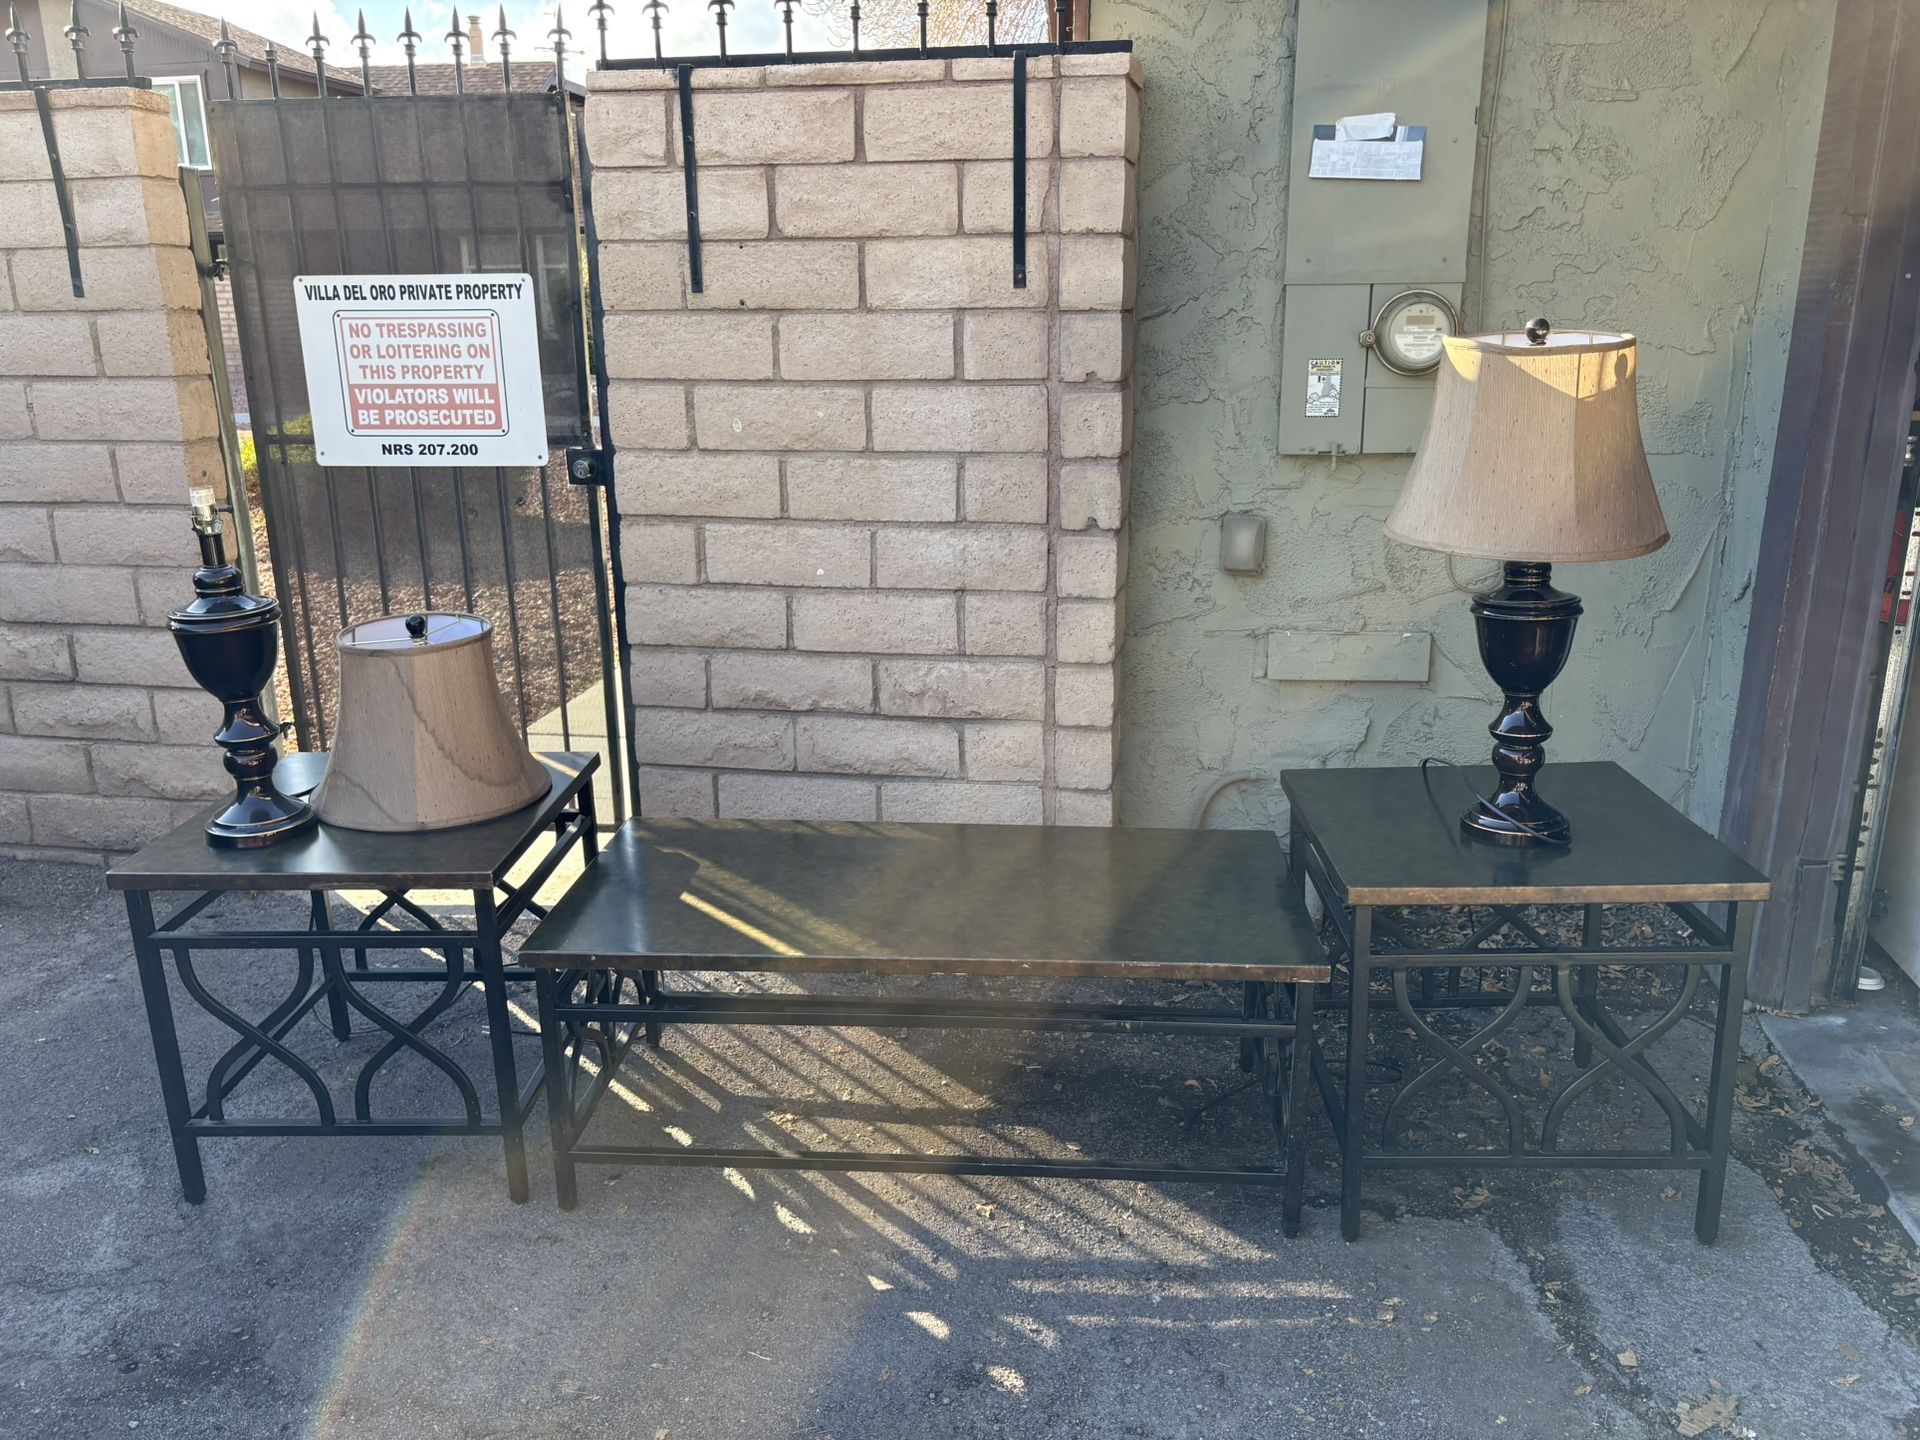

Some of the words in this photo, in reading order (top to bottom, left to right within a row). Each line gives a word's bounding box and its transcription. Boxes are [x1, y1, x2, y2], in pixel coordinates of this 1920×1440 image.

[304, 285, 341, 301] VILLA
[343, 285, 367, 300] DEL
[370, 285, 396, 300] ORO
[400, 284, 452, 300] PRIVATE
[456, 283, 522, 300] PROPERTY
[349, 323, 371, 338] NO
[376, 323, 487, 338] TRESPASSING
[350, 344, 372, 359] OR
[377, 344, 462, 359] LOITERING
[467, 344, 490, 358] ON
[359, 365, 396, 380] THIS
[402, 365, 484, 379] PROPERTY
[355, 389, 448, 404] VIOLATORS
[453, 389, 494, 404] WILL
[358, 410, 380, 425] BE
[385, 410, 496, 425] PROSECUTED
[382, 444, 413, 455] NRS
[418, 444, 478, 455] 207.200
